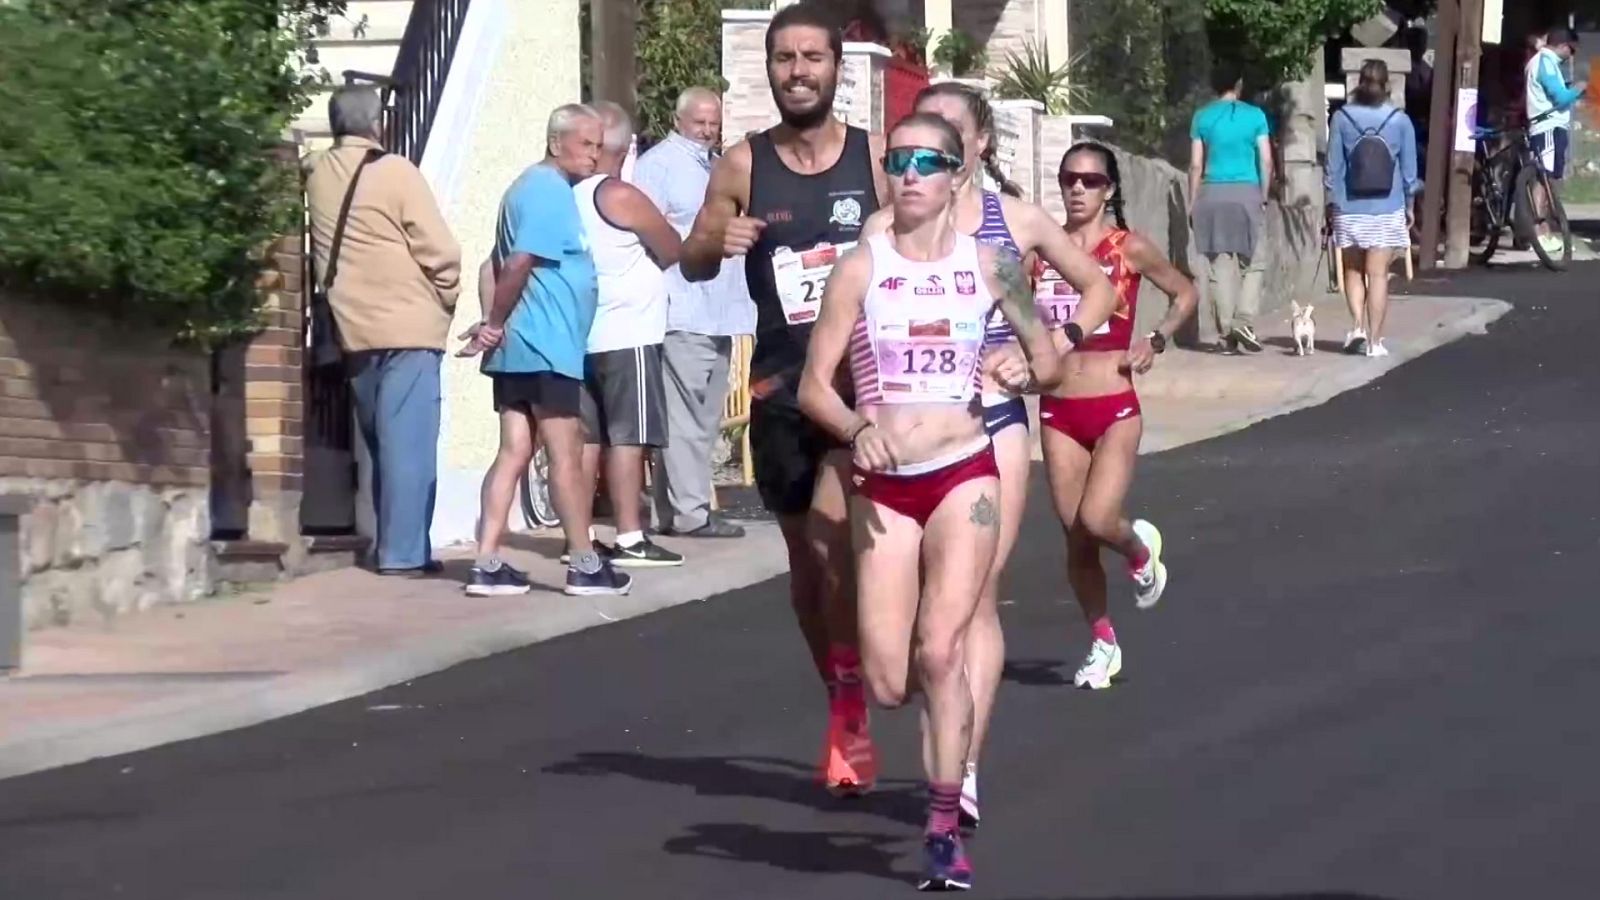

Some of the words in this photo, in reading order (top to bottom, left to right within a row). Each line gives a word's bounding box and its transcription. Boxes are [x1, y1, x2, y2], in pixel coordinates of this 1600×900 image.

[879, 277, 907, 290] 4F
[1050, 304, 1078, 322] 11
[902, 349, 956, 374] 128
